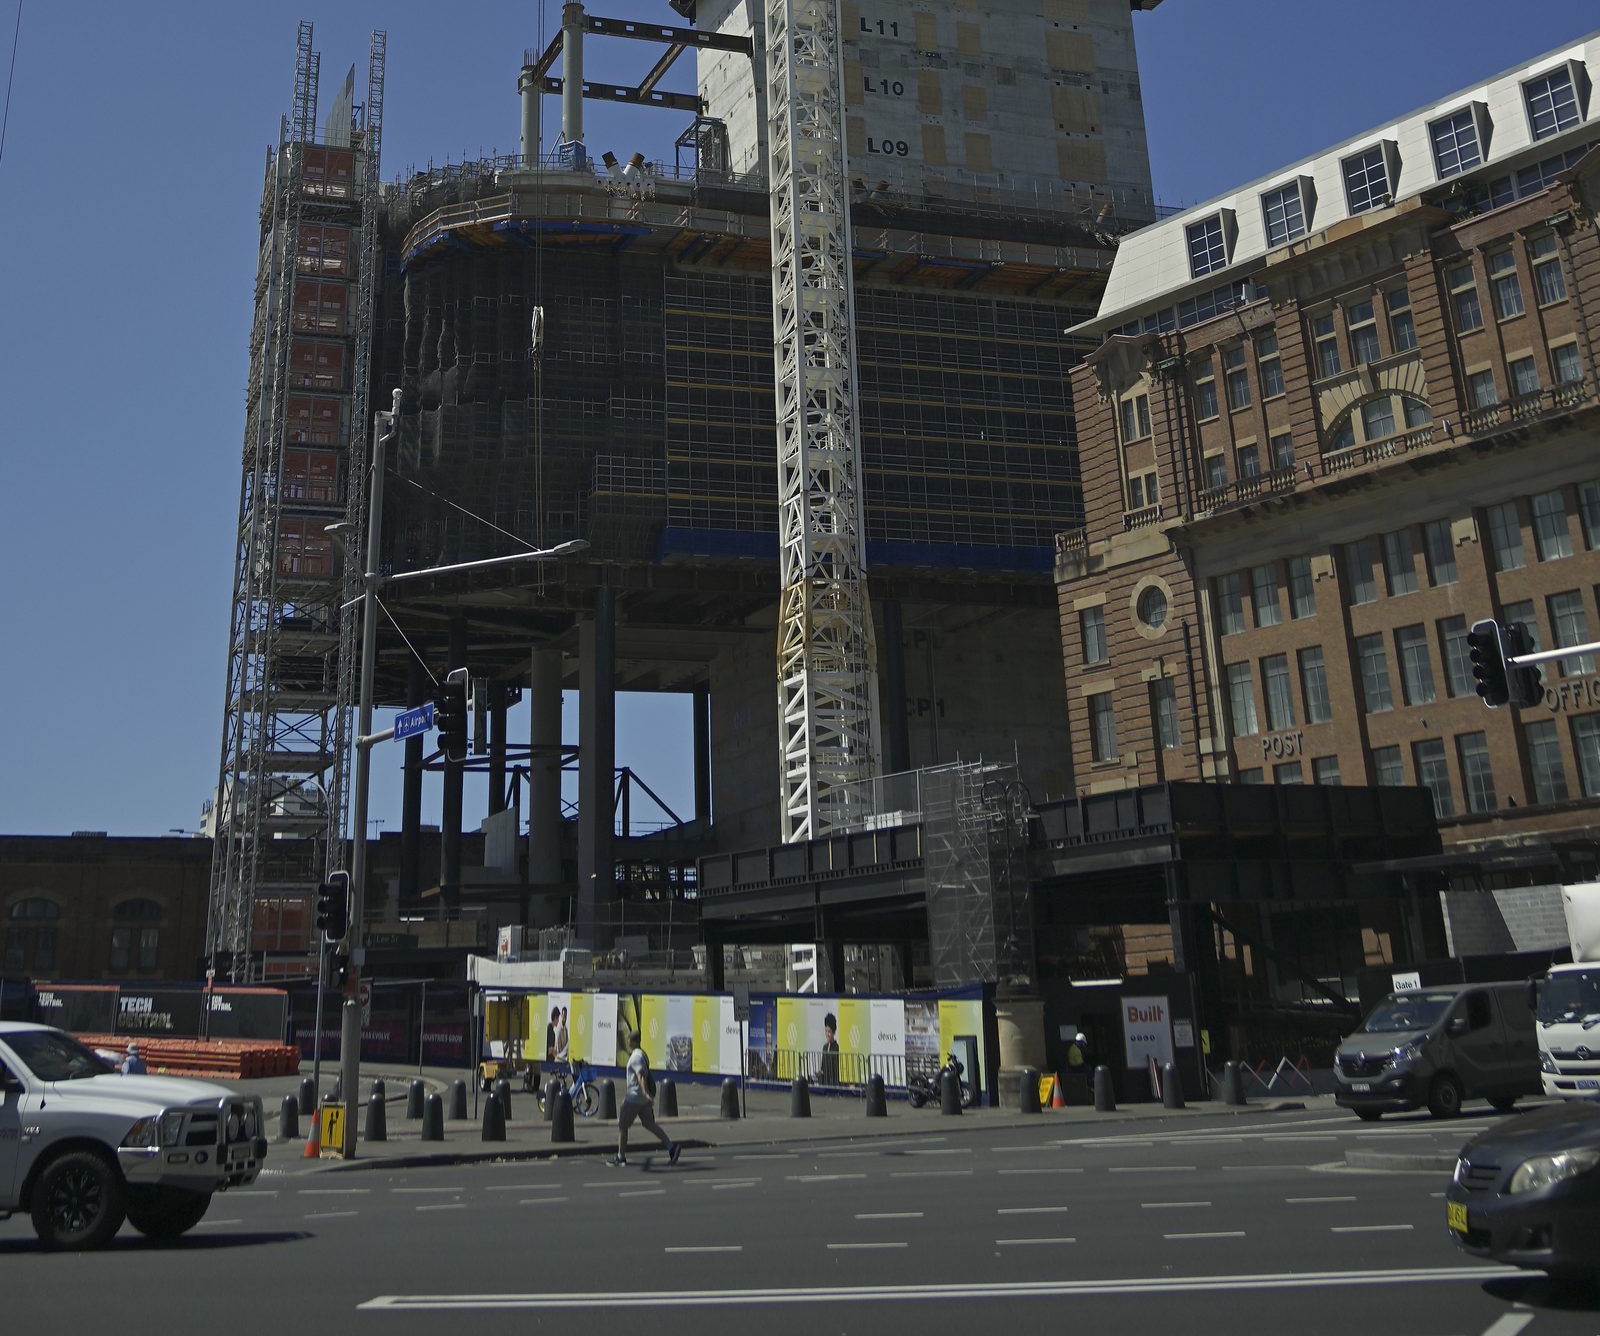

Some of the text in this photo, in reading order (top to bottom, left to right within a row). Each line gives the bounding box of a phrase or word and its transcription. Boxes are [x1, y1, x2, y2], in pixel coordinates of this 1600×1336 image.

[860, 17, 899, 37] L11
[863, 76, 904, 96] L10
[867, 137, 909, 157] L09
[1262, 731, 1304, 761] POST
[39, 992, 55, 1000] TECH
[119, 997, 153, 1012] TECH
[1127, 1004, 1164, 1023] Built
[597, 1019, 612, 1030] dexus
[877, 1031, 897, 1042] dexus
